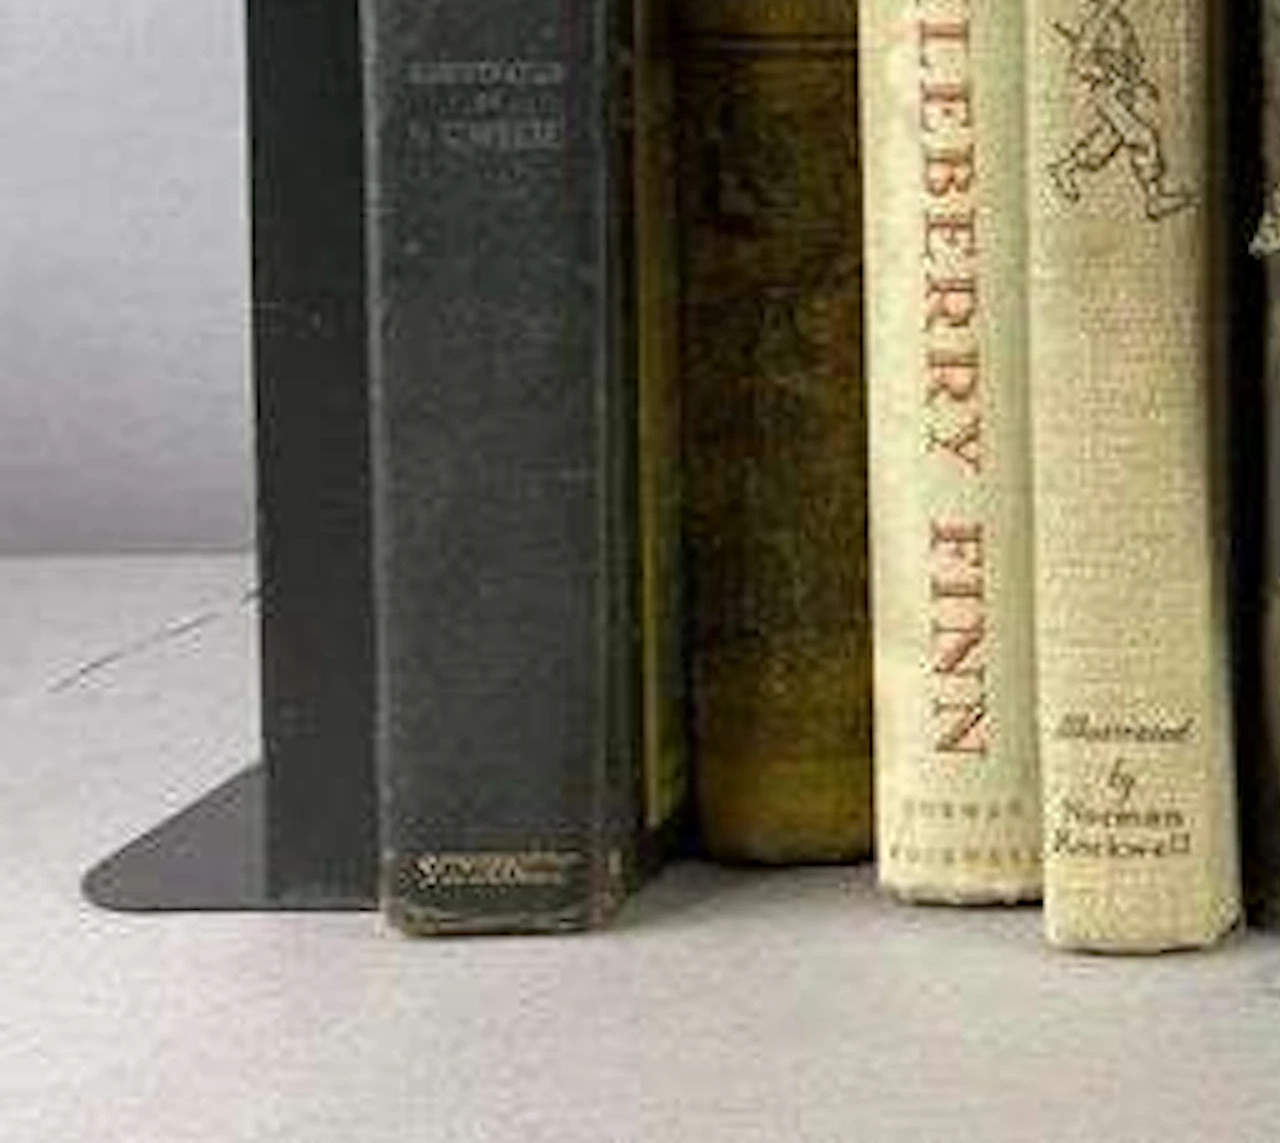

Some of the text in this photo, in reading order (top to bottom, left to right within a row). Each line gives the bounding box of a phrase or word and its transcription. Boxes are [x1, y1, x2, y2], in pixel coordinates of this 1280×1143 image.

[930, 519, 988, 758] FINN
[1105, 758, 1137, 798] by
[1062, 802, 1185, 830] Norman
